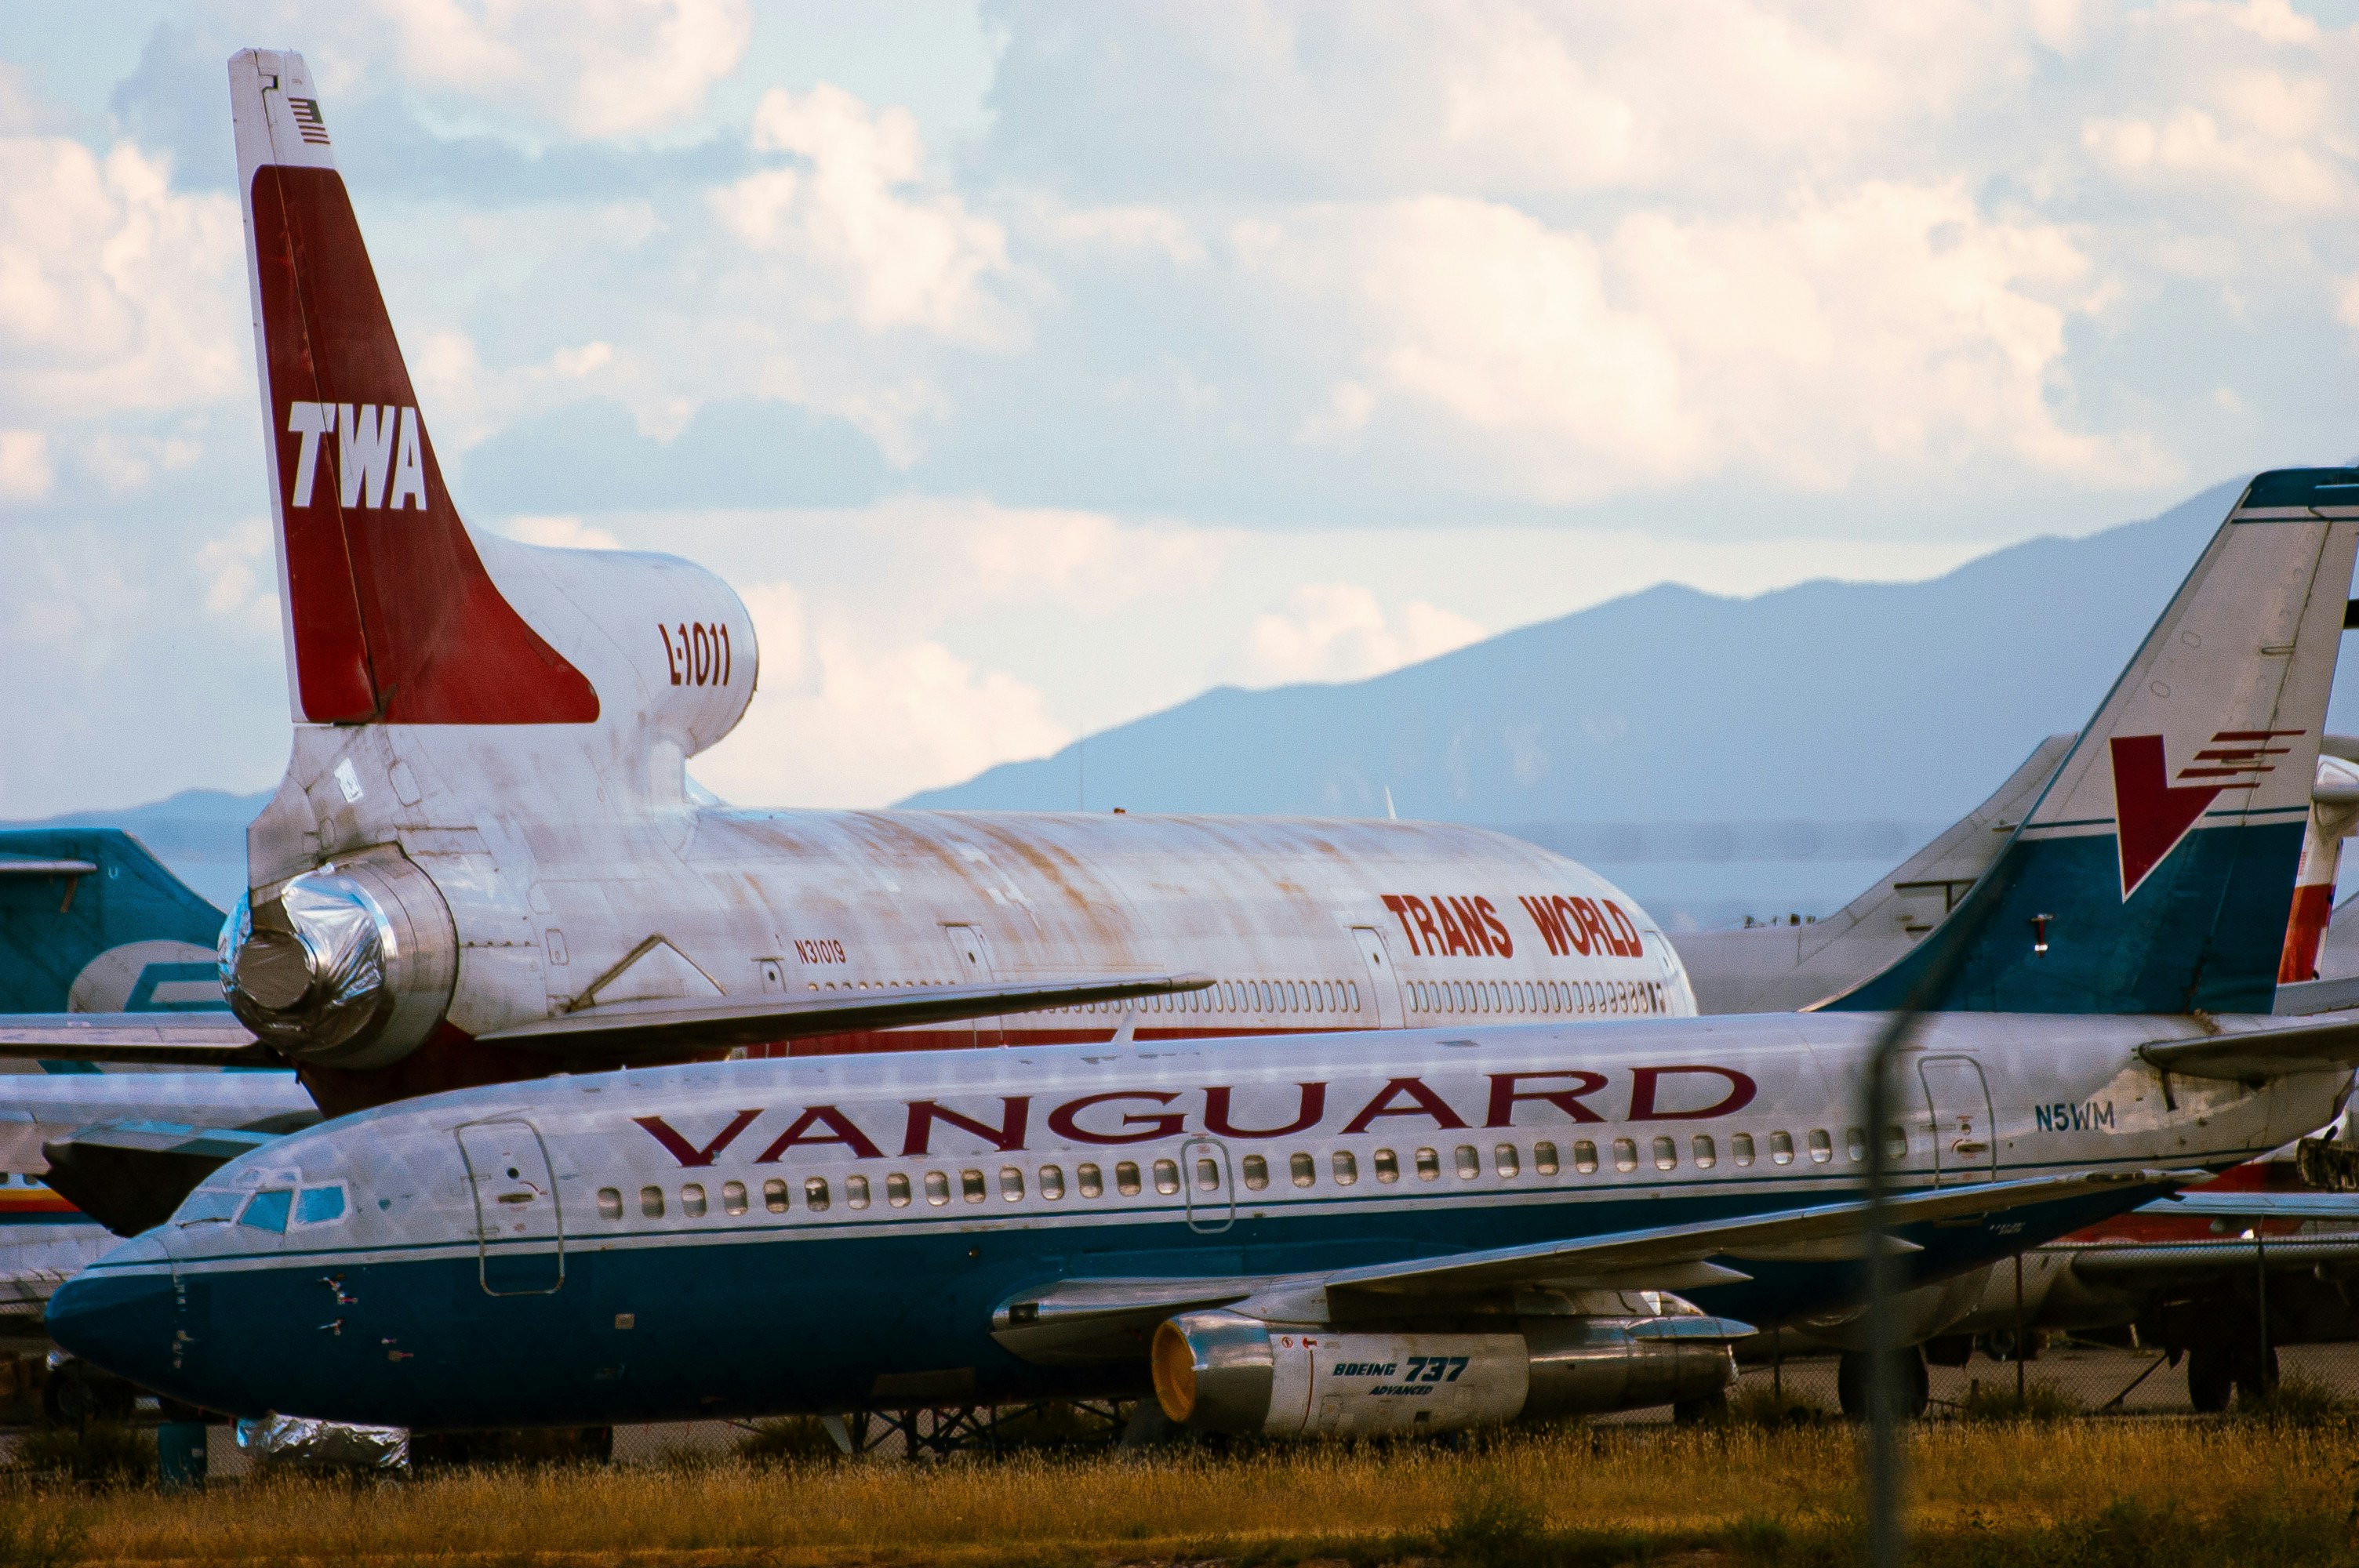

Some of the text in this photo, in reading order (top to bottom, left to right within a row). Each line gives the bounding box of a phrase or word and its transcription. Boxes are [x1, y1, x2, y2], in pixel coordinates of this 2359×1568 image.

[288, 401, 427, 510] TWA
[657, 622, 731, 687] L-1011
[1381, 895, 1644, 959] TRANS WORLD
[794, 939, 846, 964] N31019
[631, 1065, 1758, 1167] VANGUARD
[2034, 1100, 2115, 1132] N5WM
[1333, 1356, 1470, 1382] BOEING 737
[1368, 1385, 1434, 1396] ADVANCED
